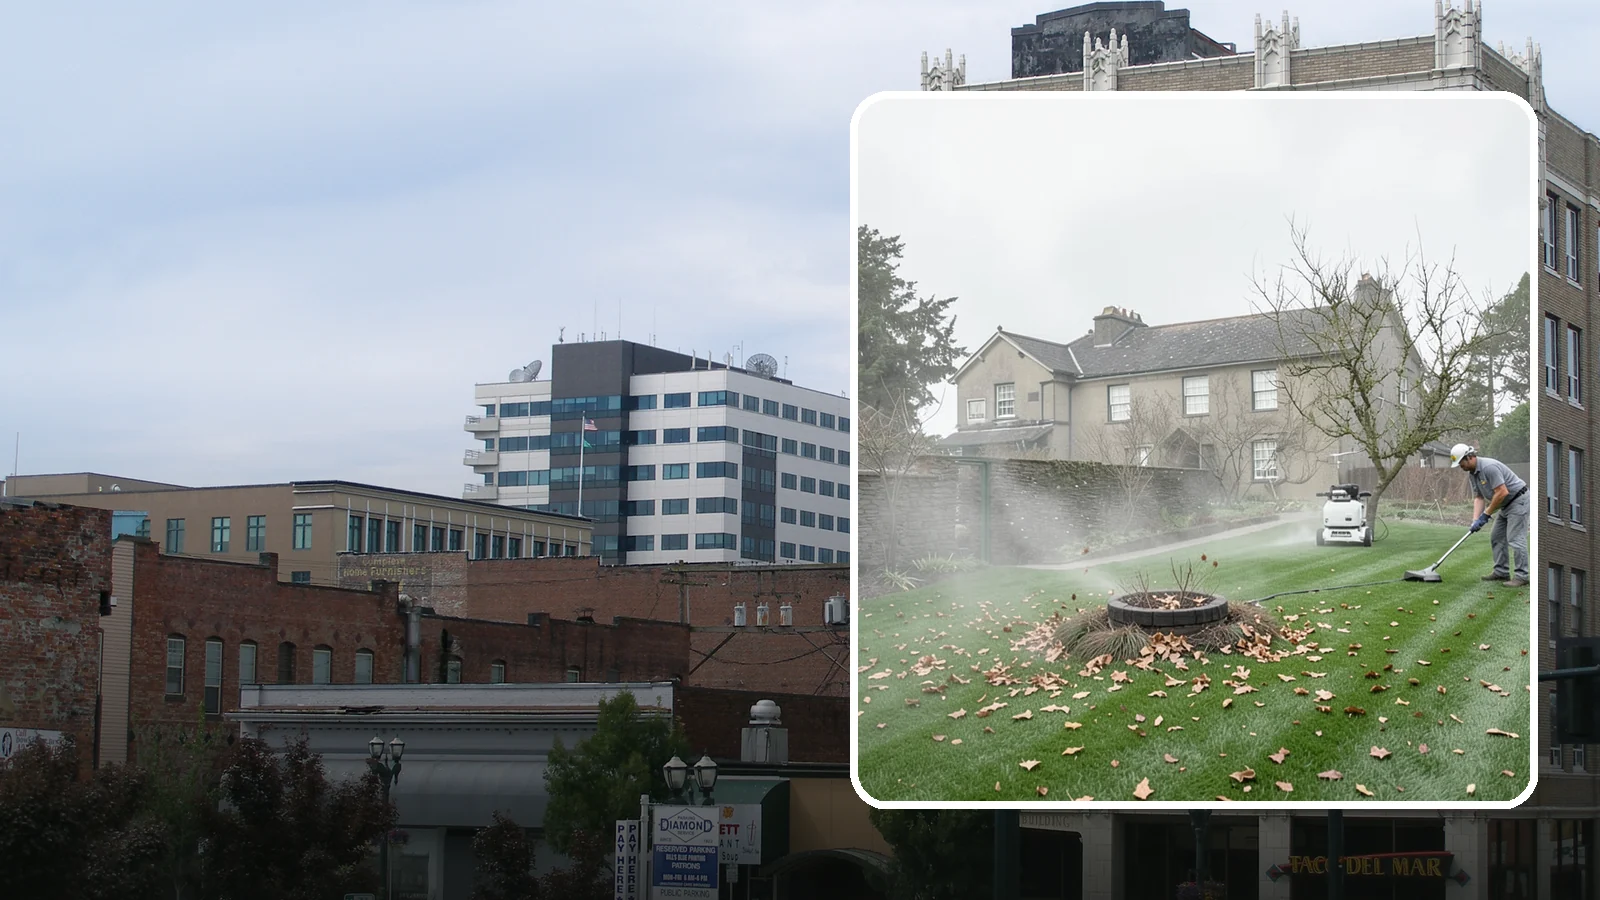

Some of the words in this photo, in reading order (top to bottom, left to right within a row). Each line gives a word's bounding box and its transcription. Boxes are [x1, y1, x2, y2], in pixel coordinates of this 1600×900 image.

[370, 566, 427, 577] Furnishers
[660, 818, 713, 833] DIAMOND
[1022, 815, 1070, 828] BUILDING
[617, 825, 625, 852] PAY
[629, 825, 637, 852] PAY
[656, 845, 688, 853] RESERVED
[689, 846, 716, 854] PARKING
[671, 862, 701, 870] PATRONS
[1289, 855, 1330, 875] TAC
[1345, 856, 1385, 876] DEL
[1391, 857, 1442, 877] MAR
[617, 856, 625, 893] HERE
[628, 856, 636, 893] HERE
[660, 888, 682, 897] PUBLIC
[683, 889, 710, 898] PARKING
